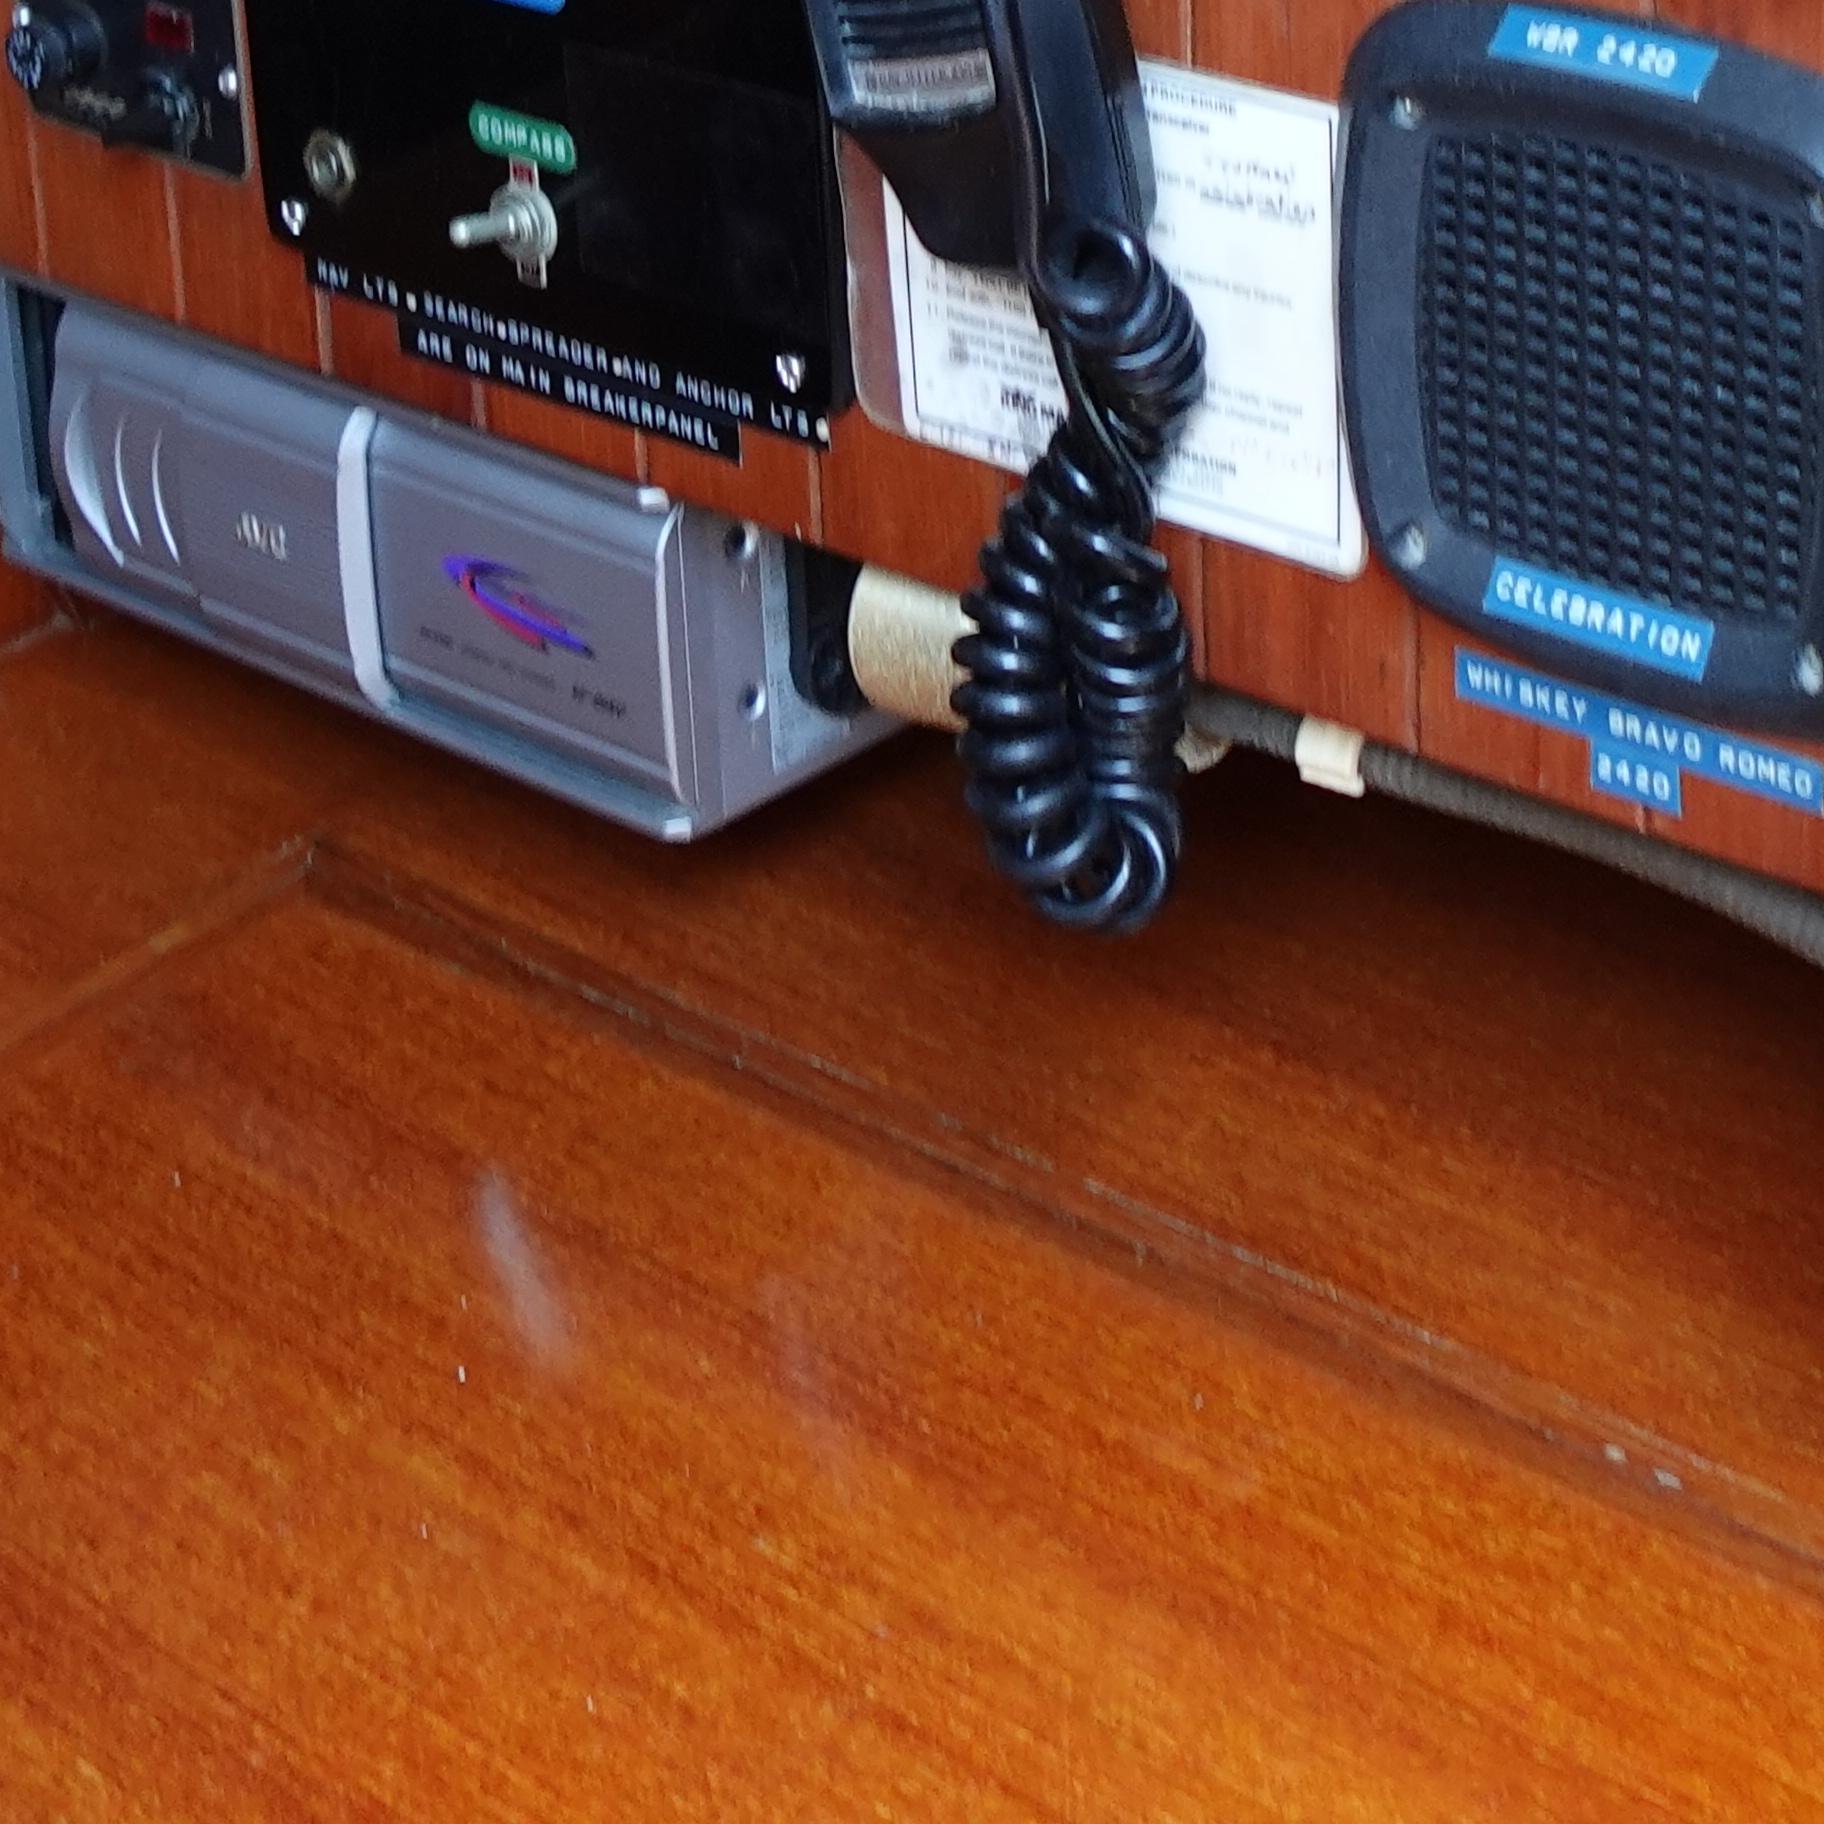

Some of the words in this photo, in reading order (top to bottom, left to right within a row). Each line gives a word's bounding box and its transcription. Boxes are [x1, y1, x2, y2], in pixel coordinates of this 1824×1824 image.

[1526, 19, 1580, 58] WBR
[1596, 32, 1676, 80] 2420
[477, 112, 568, 164] COMPASS
[316, 255, 350, 290] NAV
[362, 272, 399, 308] LTS
[676, 370, 755, 422] ANCHOR
[417, 327, 454, 365] ARE
[465, 342, 492, 376] ON
[501, 353, 552, 397] MAIN
[1495, 568, 1703, 664] CELEBRATION
[1465, 657, 1589, 725] WHISKEY
[1606, 705, 1702, 764] BRAVO
[1717, 741, 1814, 802] ROMEO
[1596, 750, 1672, 803] 2420
